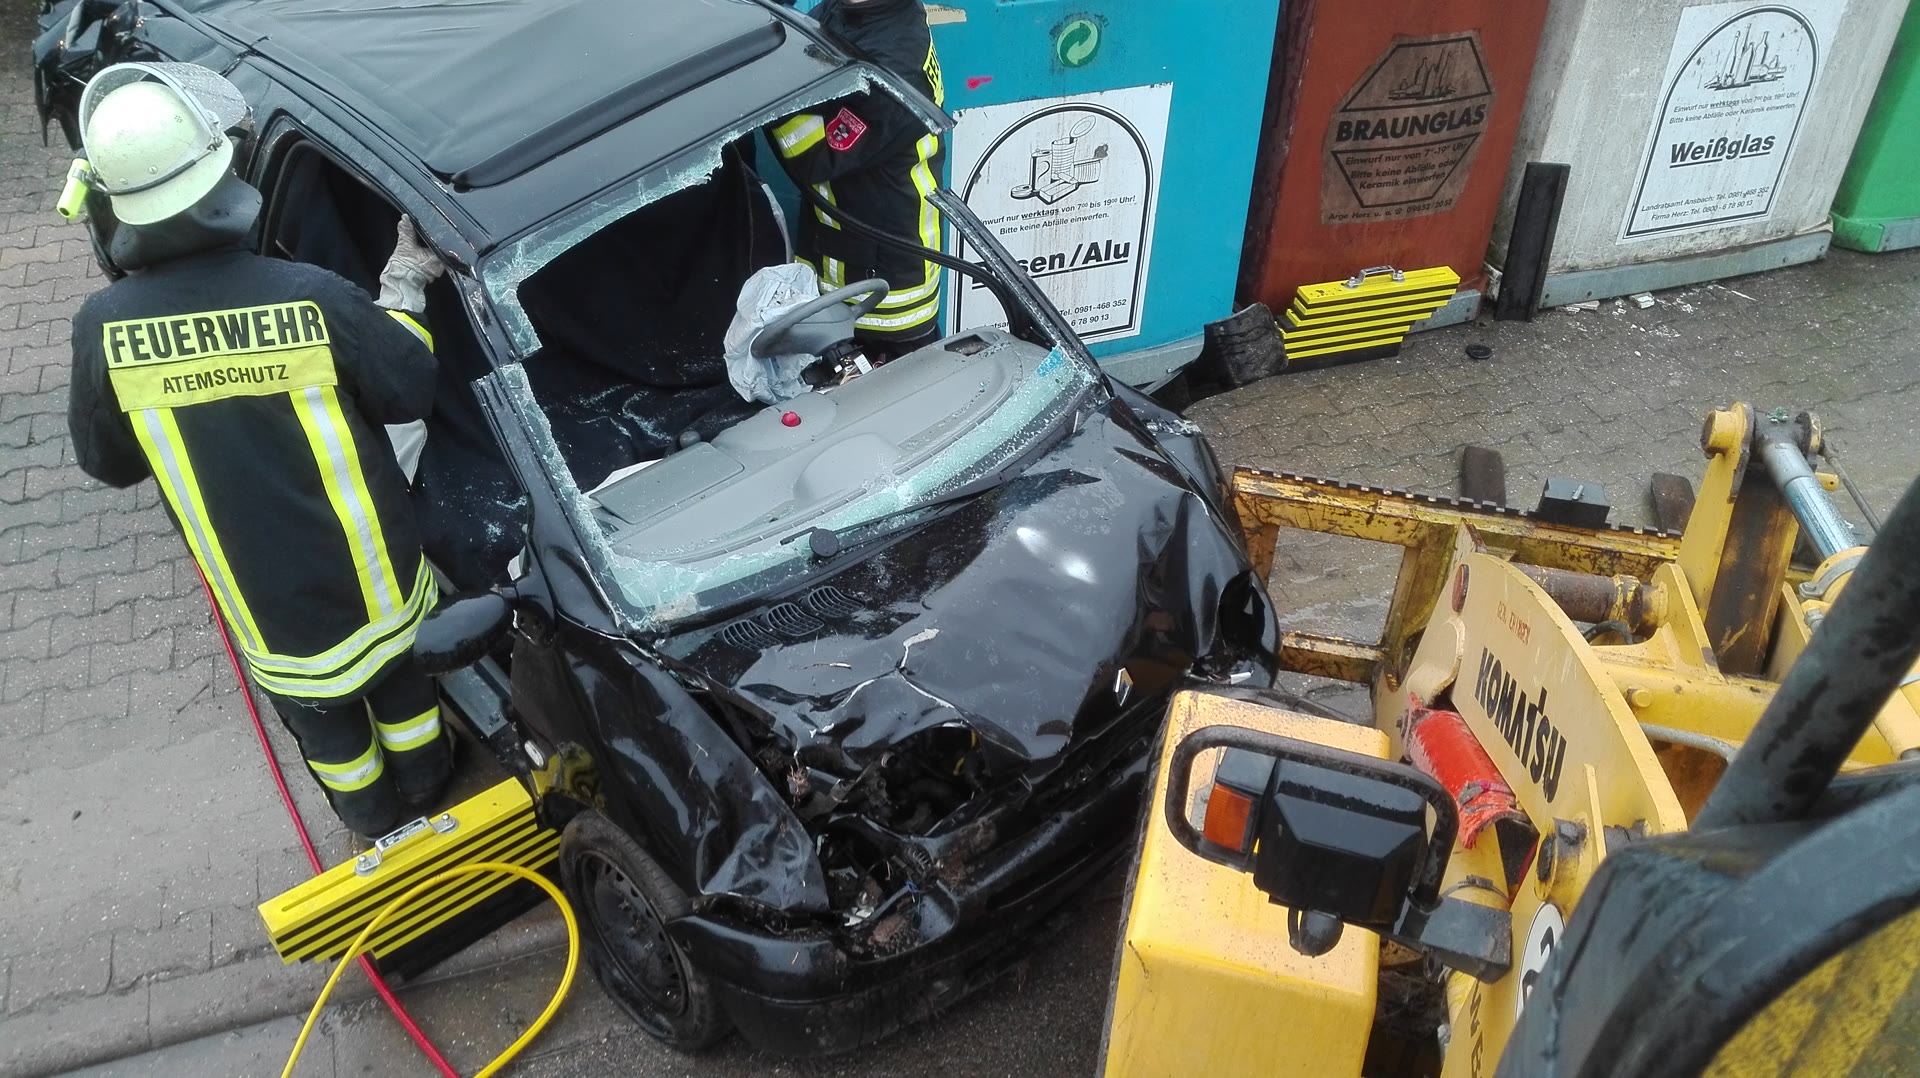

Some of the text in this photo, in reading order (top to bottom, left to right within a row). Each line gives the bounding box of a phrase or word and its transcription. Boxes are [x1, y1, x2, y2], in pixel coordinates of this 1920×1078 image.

[1335, 103, 1486, 143] BRAUNGLAS
[1345, 154, 1383, 165] Einwurf
[1404, 152, 1421, 160] von
[1671, 134, 1776, 163] Weißglas
[1351, 171, 1373, 179] Bitte
[1375, 168, 1401, 177] keine
[1404, 162, 1436, 174] Abfälle
[1359, 172, 1446, 189] Keramik einwerfen
[1006, 214, 1020, 222] nur
[1021, 208, 1060, 221] werktags
[1061, 205, 1076, 213] von
[1089, 201, 1101, 209] bis
[1119, 195, 1136, 204] Uhr!
[1000, 212, 1109, 235] Bitte keine Abfälle einwerfen.
[1074, 302, 1111, 314] 0981-468
[1112, 298, 1127, 308] 352
[1078, 317, 1088, 325] 78
[1089, 315, 1099, 323] 90
[1100, 313, 1110, 321] 13
[108, 305, 324, 364] FEUERWEHR
[162, 364, 290, 394] ATEMSCHUTZ
[1474, 645, 1568, 804] KOMATSU
